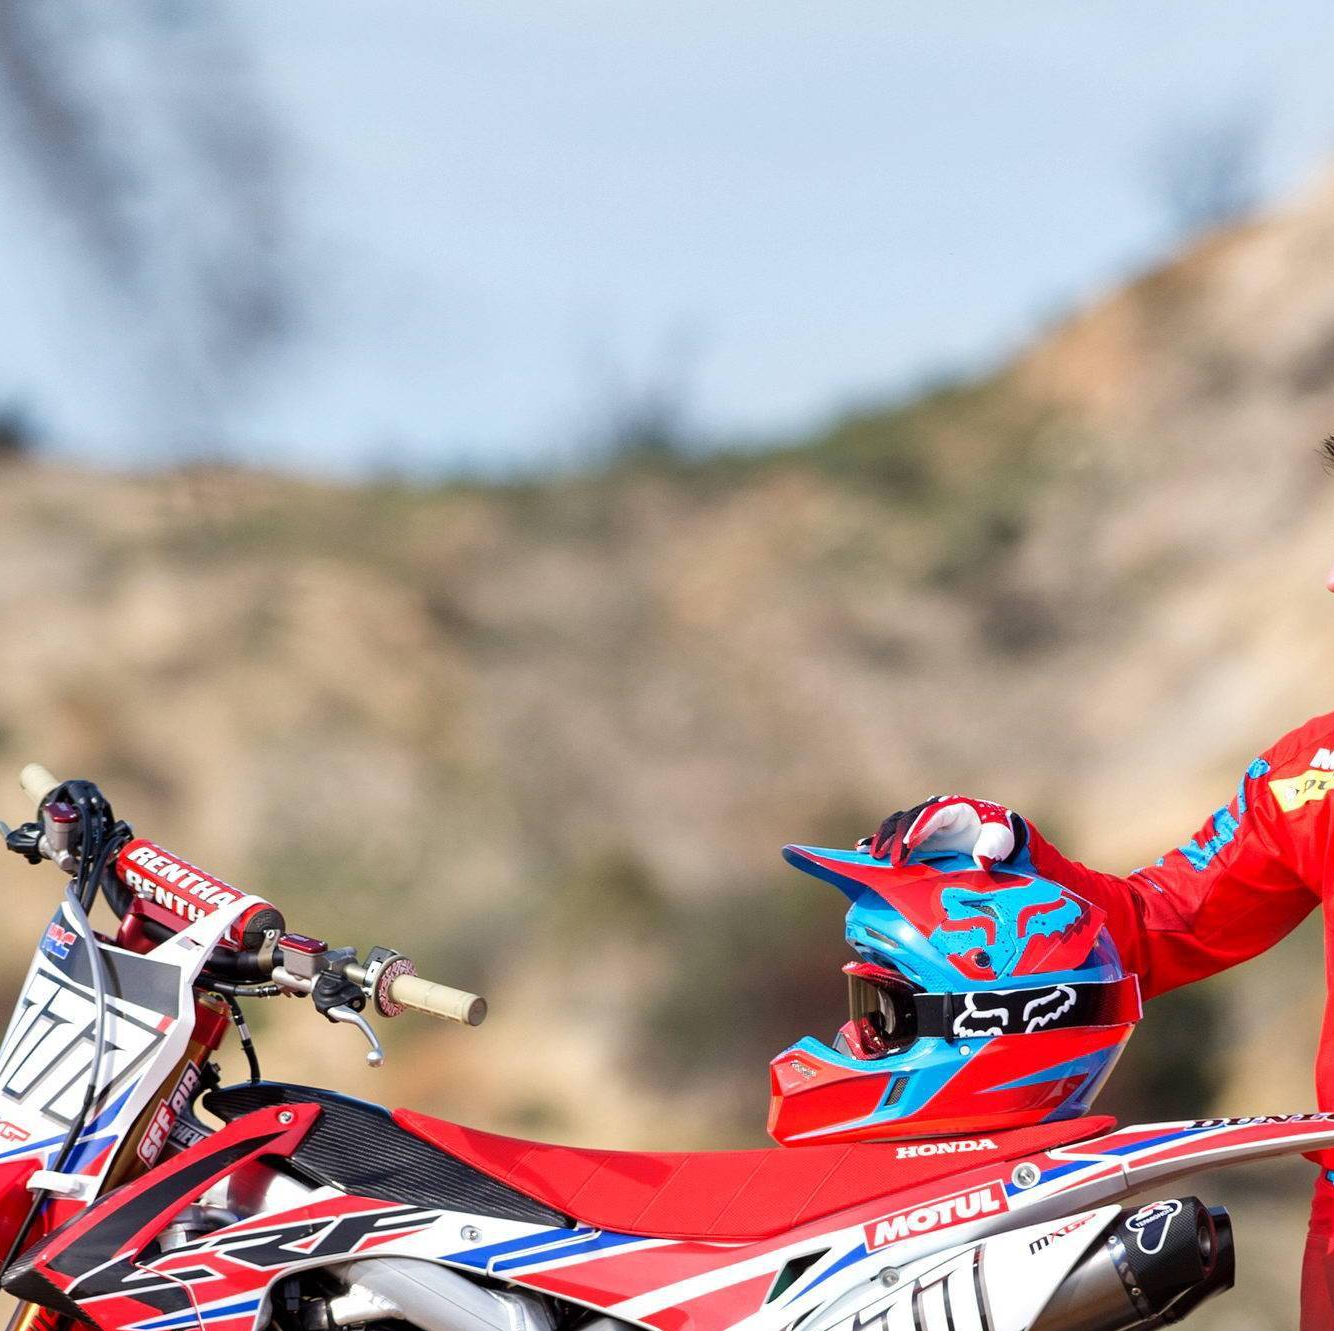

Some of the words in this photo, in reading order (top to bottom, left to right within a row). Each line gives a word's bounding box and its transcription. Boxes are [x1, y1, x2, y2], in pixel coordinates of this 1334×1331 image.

[127, 847, 237, 907] RENTHA
[172, 1068, 198, 1114] AIR
[896, 1138, 998, 1159] HONDA
[874, 1188, 1000, 1247] MOTUL
